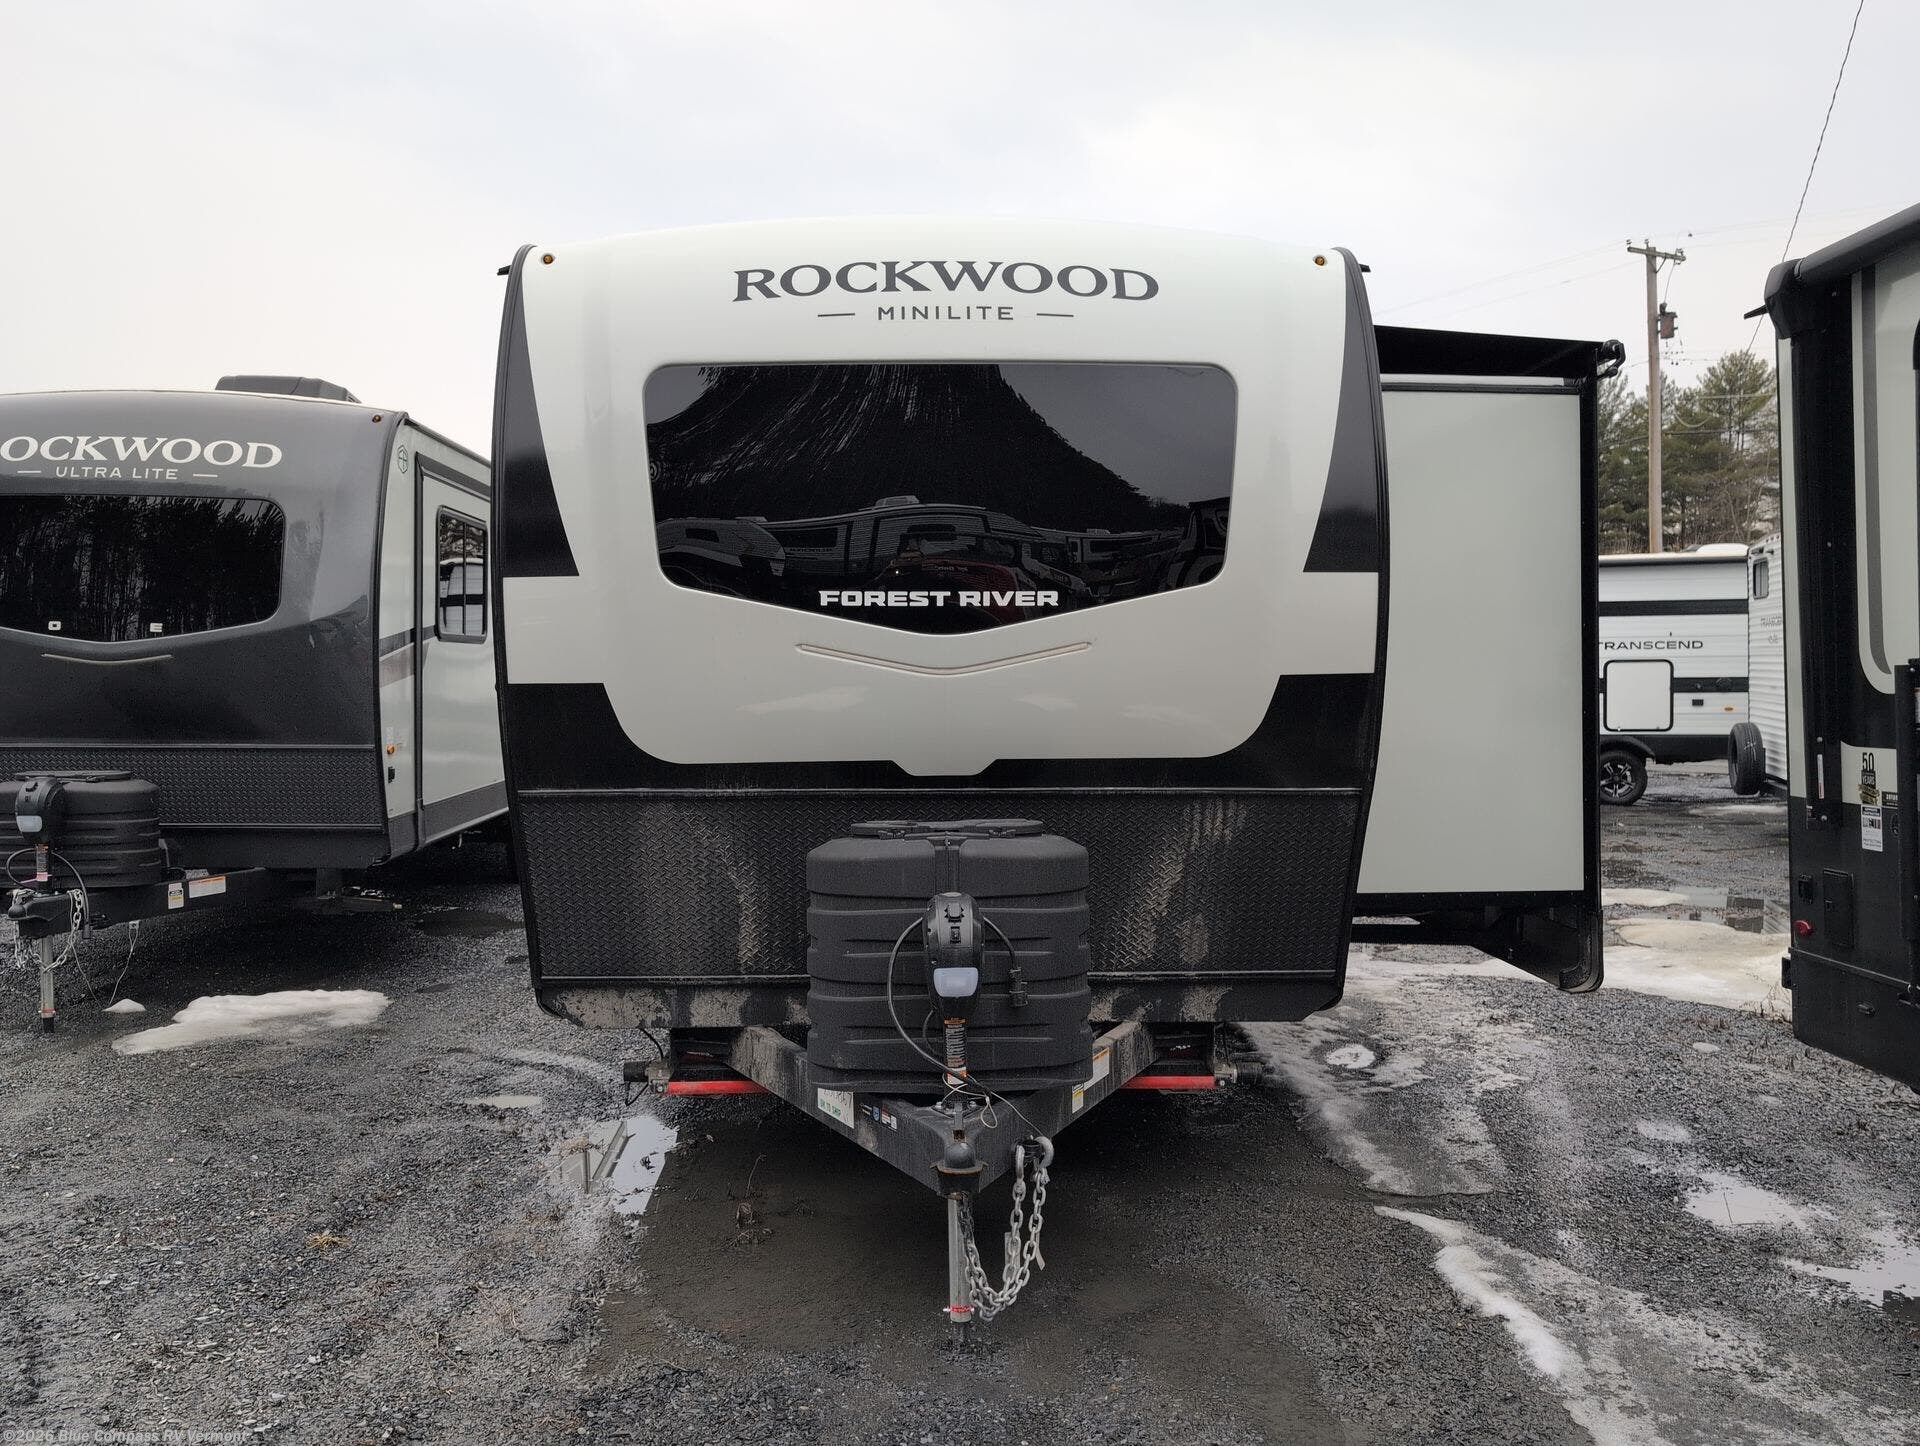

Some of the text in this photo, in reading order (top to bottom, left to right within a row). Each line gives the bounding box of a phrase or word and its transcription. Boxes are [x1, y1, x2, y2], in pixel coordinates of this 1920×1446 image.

[733, 260, 1159, 302] ROCKWOOD
[877, 305, 1014, 321] MINILITE
[0, 435, 283, 470] OCKWOOD
[55, 466, 179, 480] ULTRA LITE
[819, 590, 1059, 607] FOREST RIVER
[1599, 640, 1704, 651] RANSCEND
[1862, 752, 1875, 771] 50
